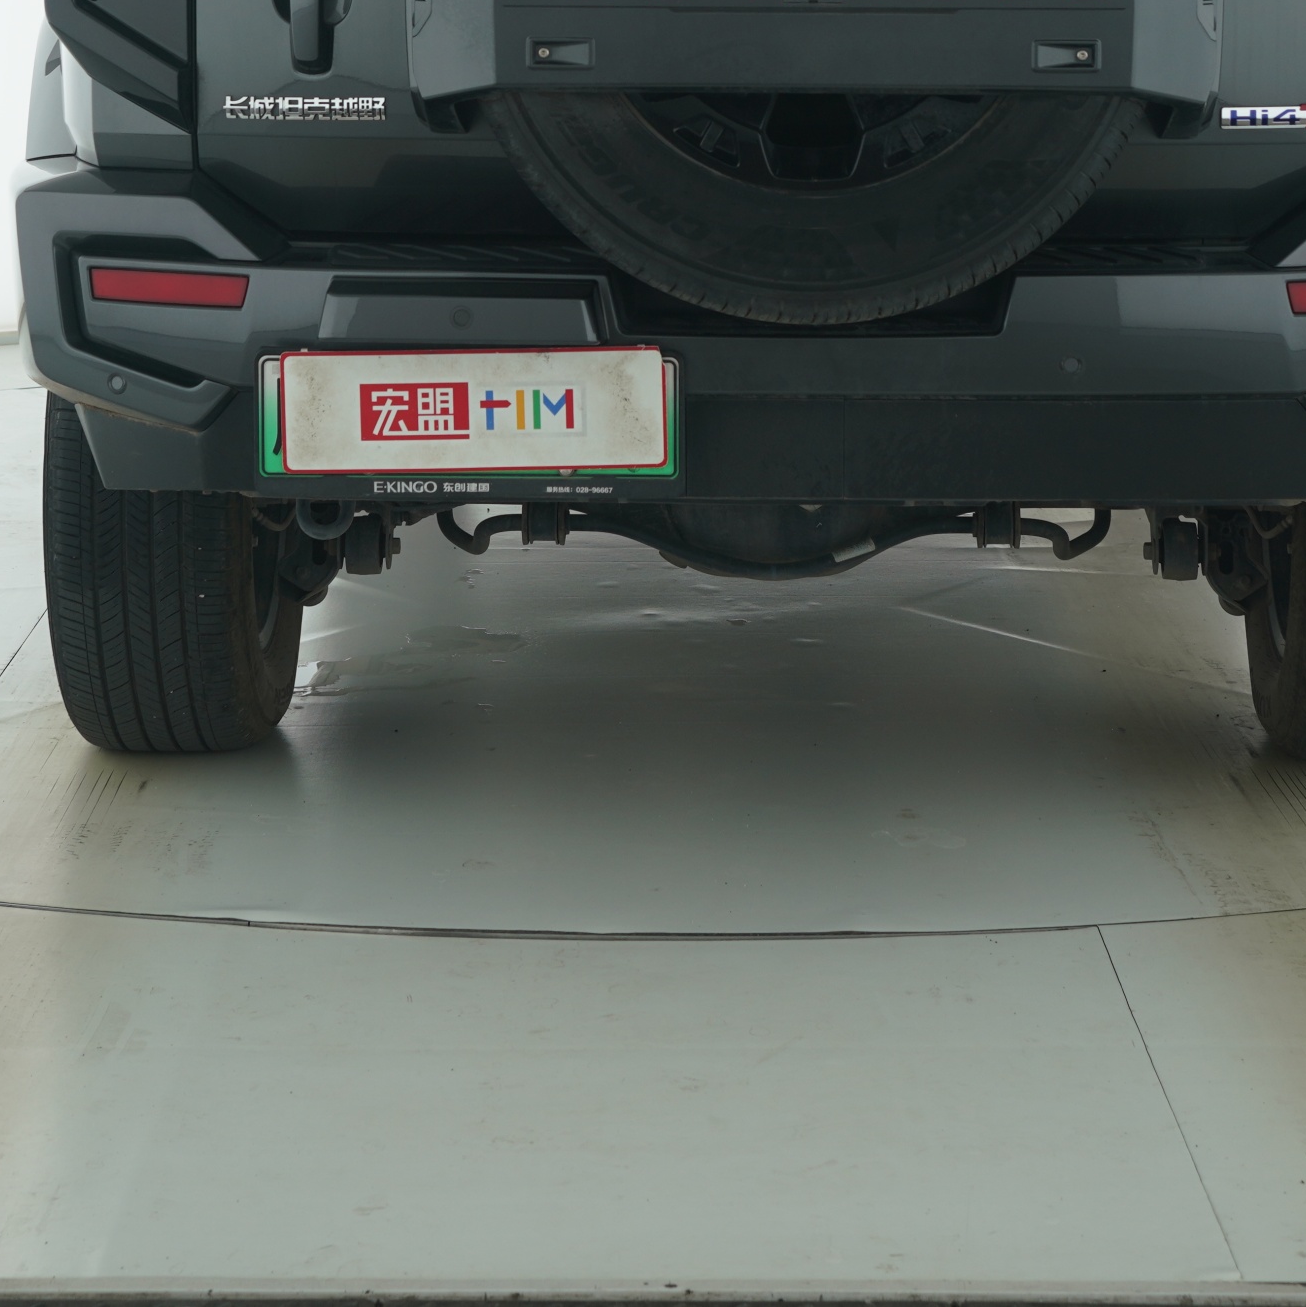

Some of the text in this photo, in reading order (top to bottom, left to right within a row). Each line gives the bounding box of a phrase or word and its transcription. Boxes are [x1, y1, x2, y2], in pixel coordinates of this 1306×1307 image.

[222, 95, 386, 121] 长城坦克越野
[370, 387, 458, 436] 宏盟
[443, 482, 490, 493] 东创建国
